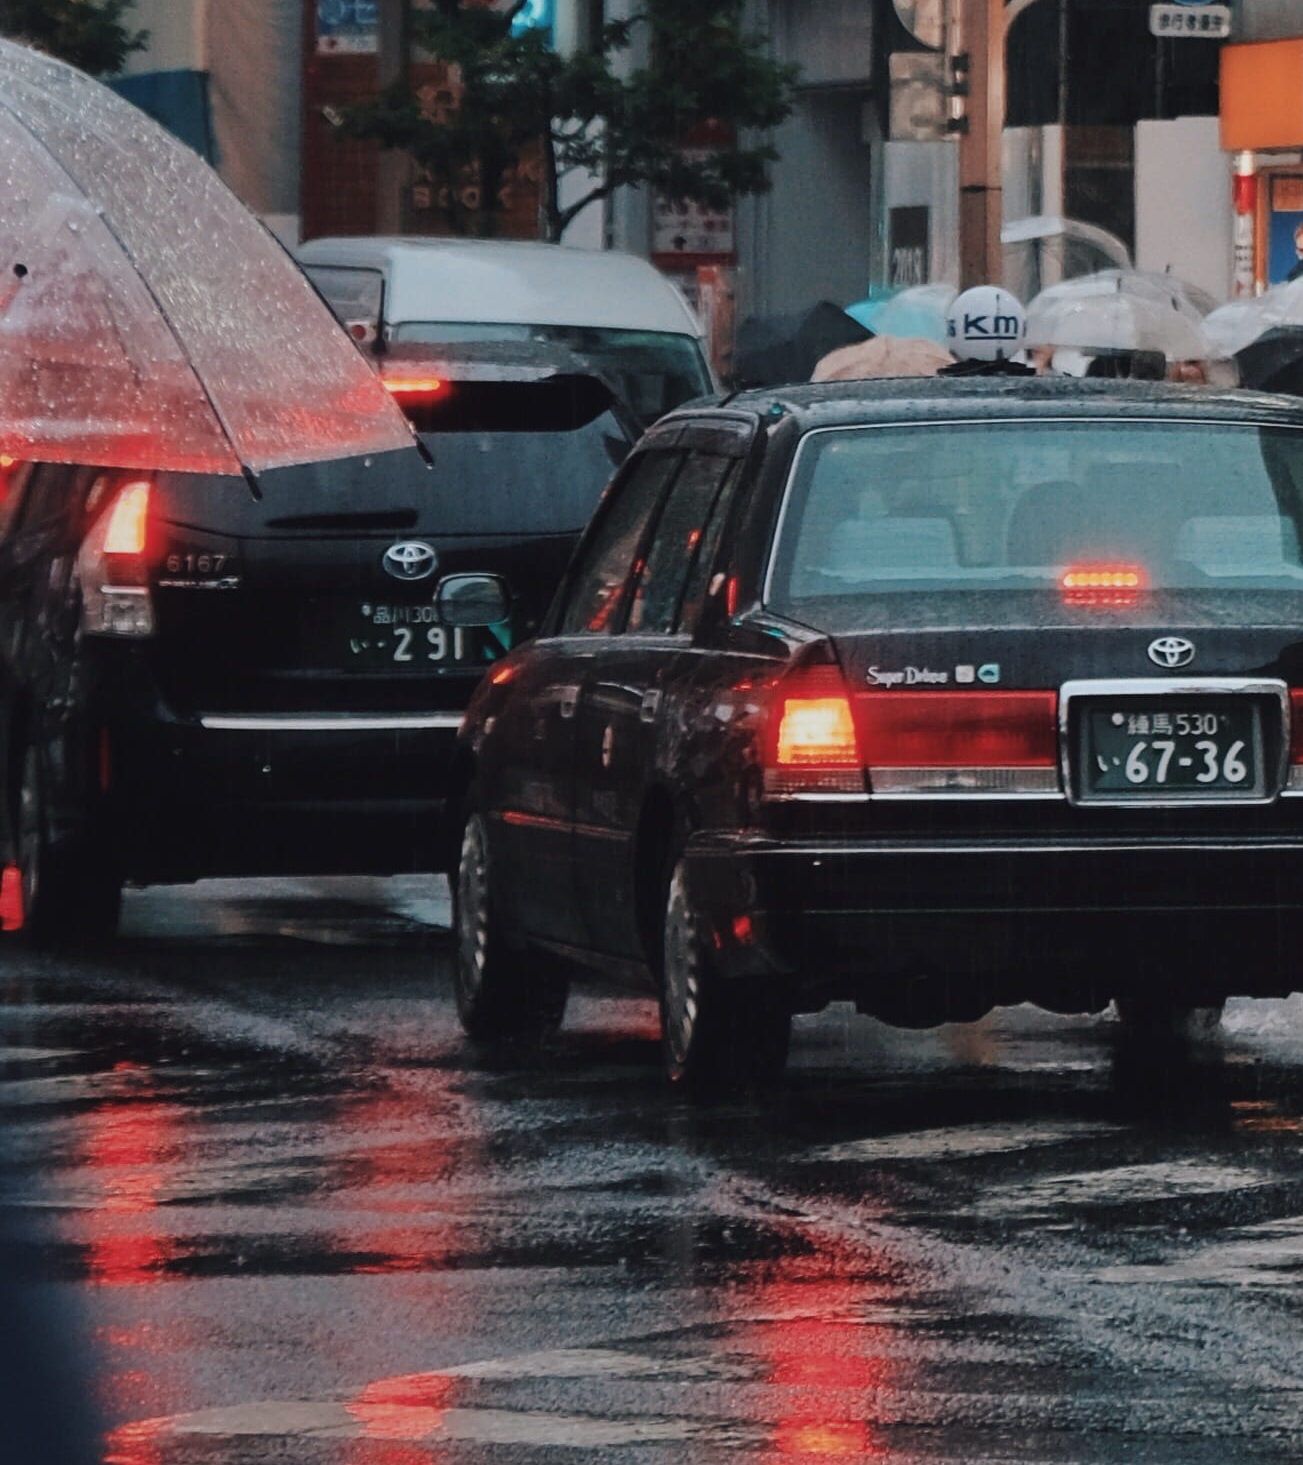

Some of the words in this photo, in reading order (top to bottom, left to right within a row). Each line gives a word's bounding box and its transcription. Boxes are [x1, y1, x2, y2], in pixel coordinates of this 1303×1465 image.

[1127, 713, 1173, 737] 練馬
[1175, 713, 1219, 737] 530
[1124, 739, 1248, 785] 67-36
